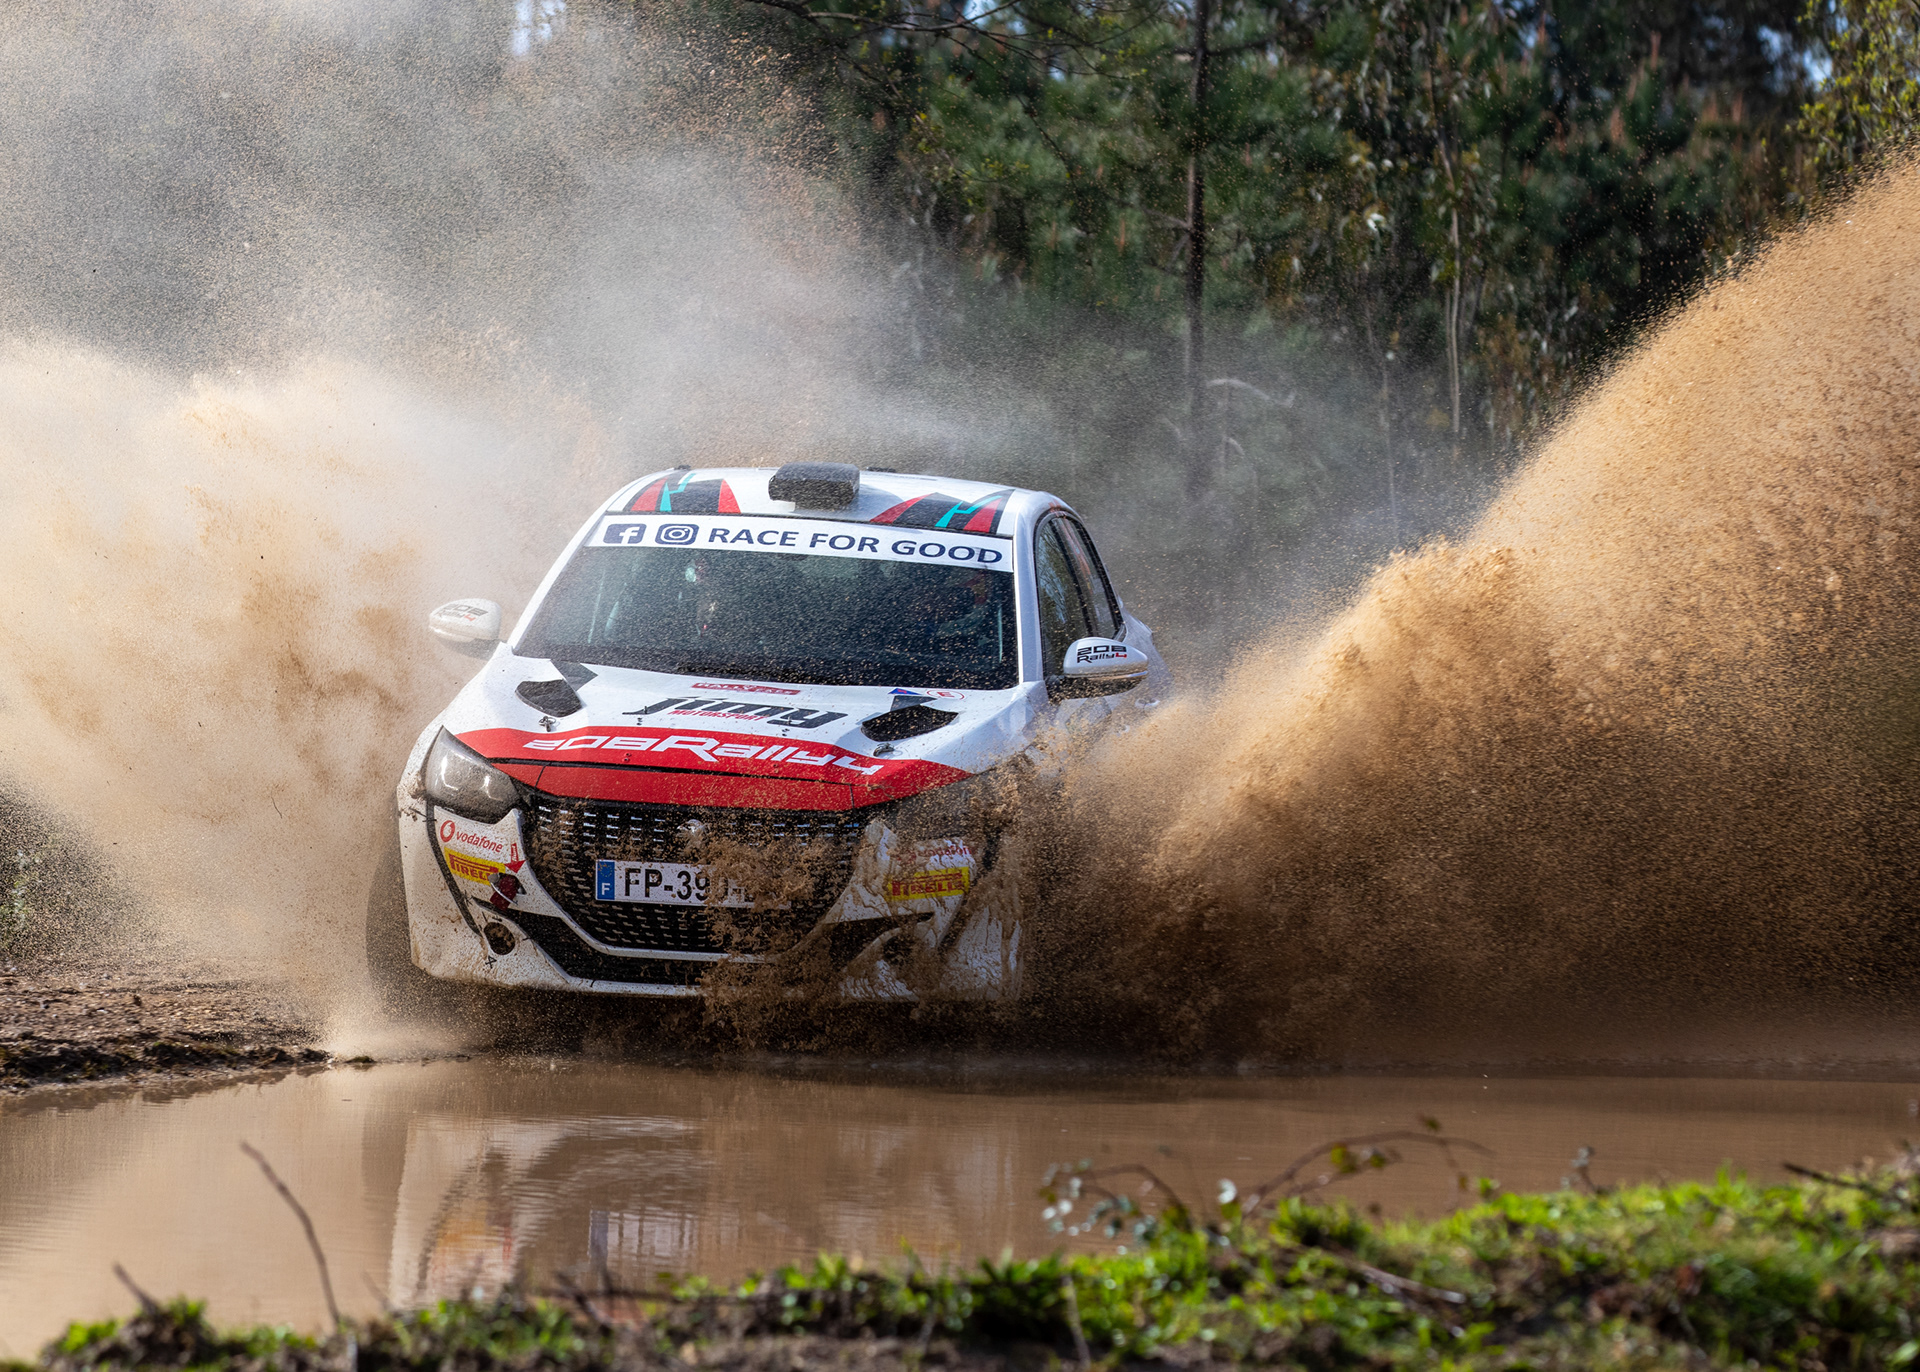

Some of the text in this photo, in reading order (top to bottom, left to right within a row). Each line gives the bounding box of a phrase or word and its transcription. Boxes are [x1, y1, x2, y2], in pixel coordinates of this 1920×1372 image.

[708, 527, 800, 547] RACE
[809, 532, 880, 553] FOR
[891, 539, 1003, 564] GOOD
[1076, 645, 1127, 656] 208
[1076, 652, 1128, 664] Rally4
[456, 830, 503, 853] vodafone
[601, 882, 612, 896] F
